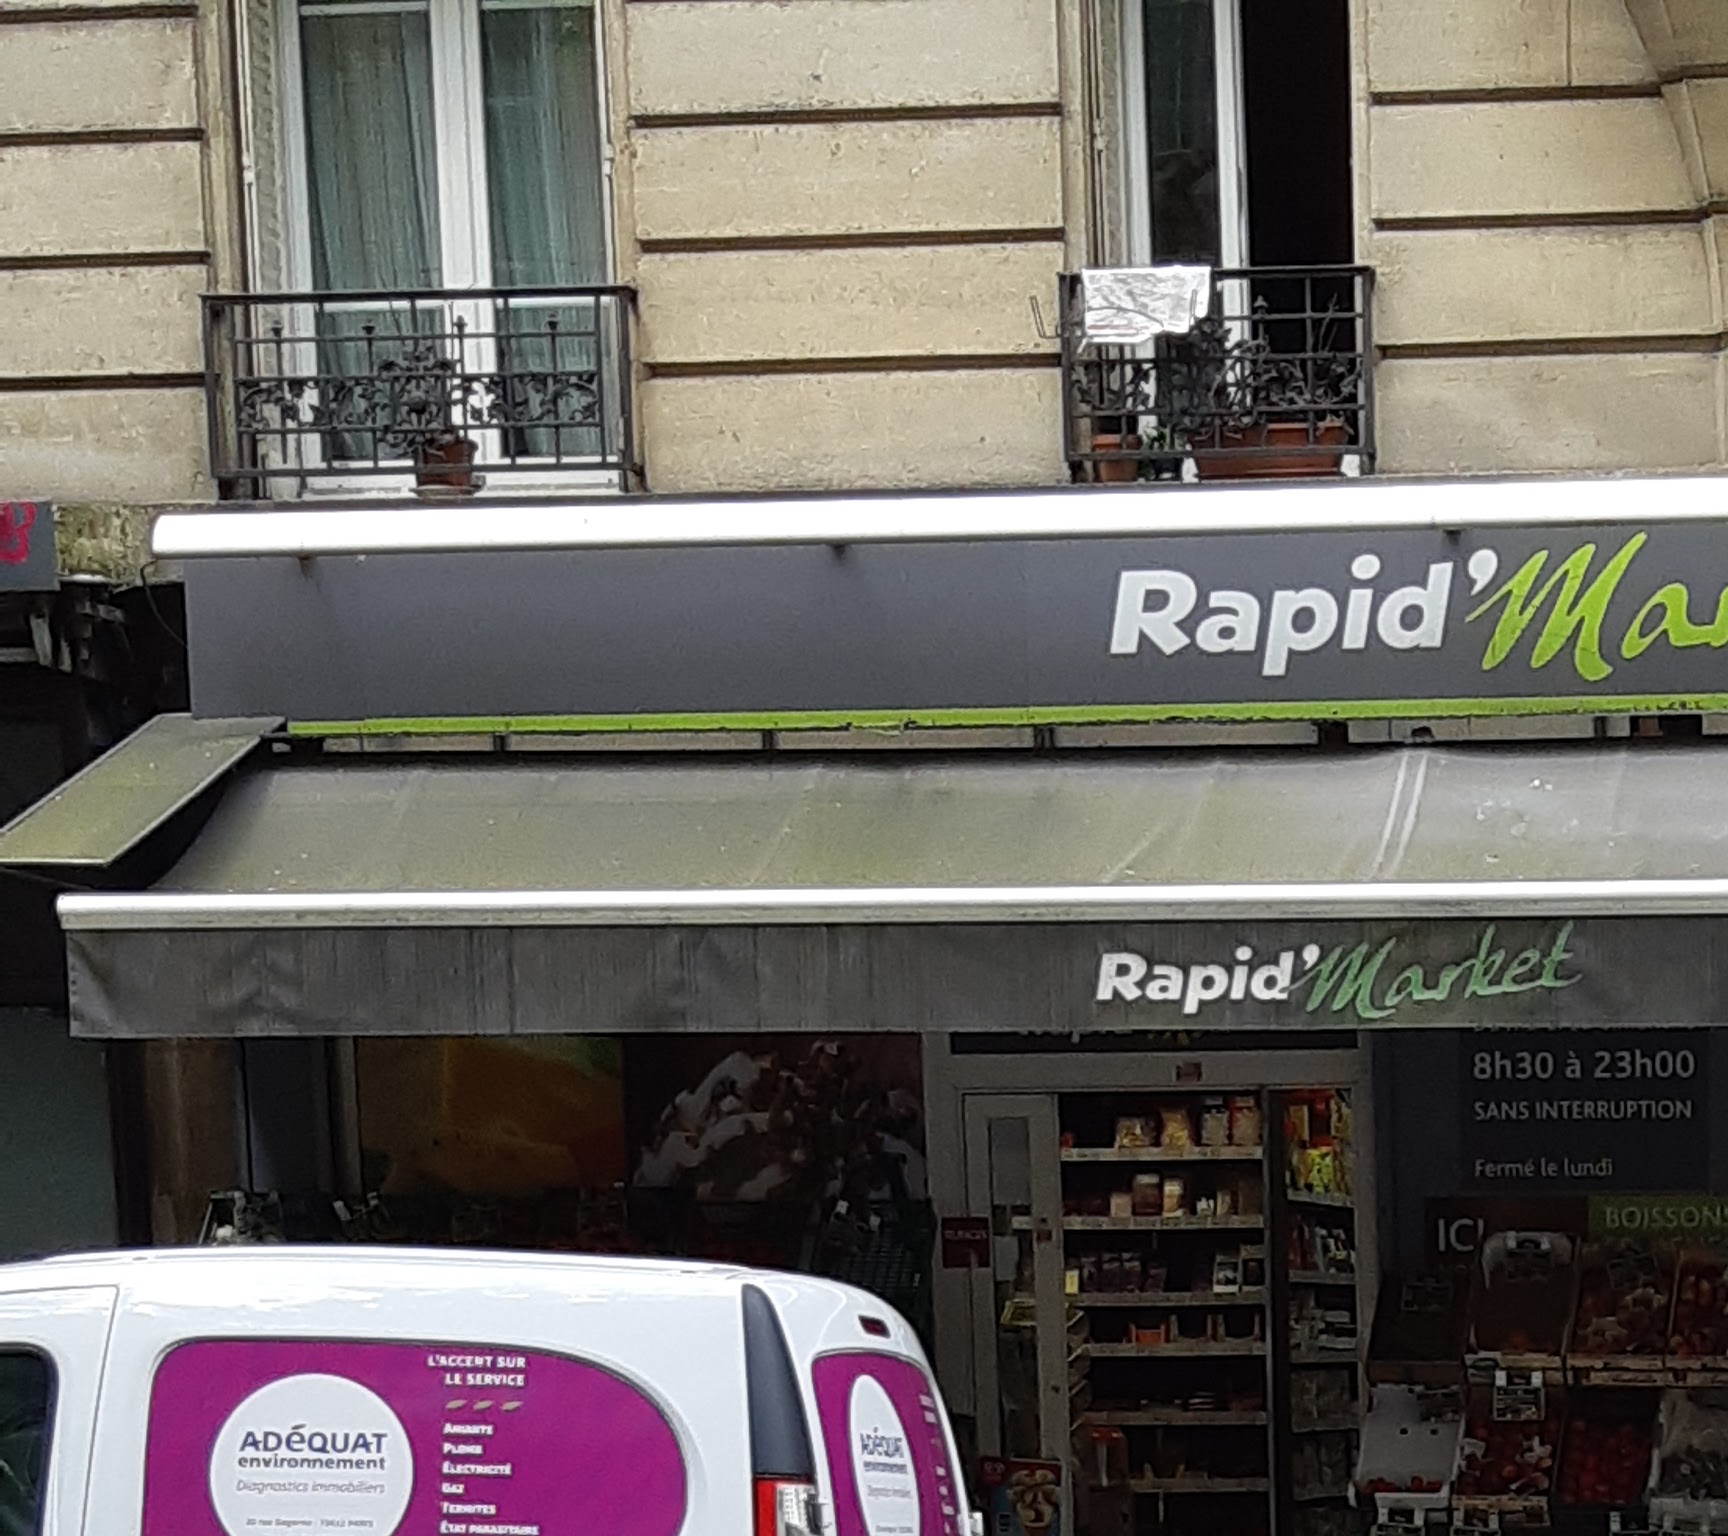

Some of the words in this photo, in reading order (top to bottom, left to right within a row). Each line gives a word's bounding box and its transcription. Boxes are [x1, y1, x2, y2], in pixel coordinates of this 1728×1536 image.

[1287, 922, 1583, 1019] Market
[1472, 1051, 1555, 1080] 8h30
[1565, 1051, 1582, 1079] à
[1594, 1050, 1696, 1079] 23h00
[1475, 1101, 1529, 1120] SANS
[1535, 1100, 1692, 1120] INTERRUPTION
[1474, 1159, 1535, 1177] Fermé
[1540, 1159, 1559, 1177] le
[1564, 1158, 1614, 1177] lundi
[428, 1354, 492, 1368] L'ACCENT
[496, 1356, 526, 1368] SUR
[445, 1373, 462, 1385] LE
[466, 1374, 525, 1386] SERVICE
[238, 1454, 386, 1471] environnement
